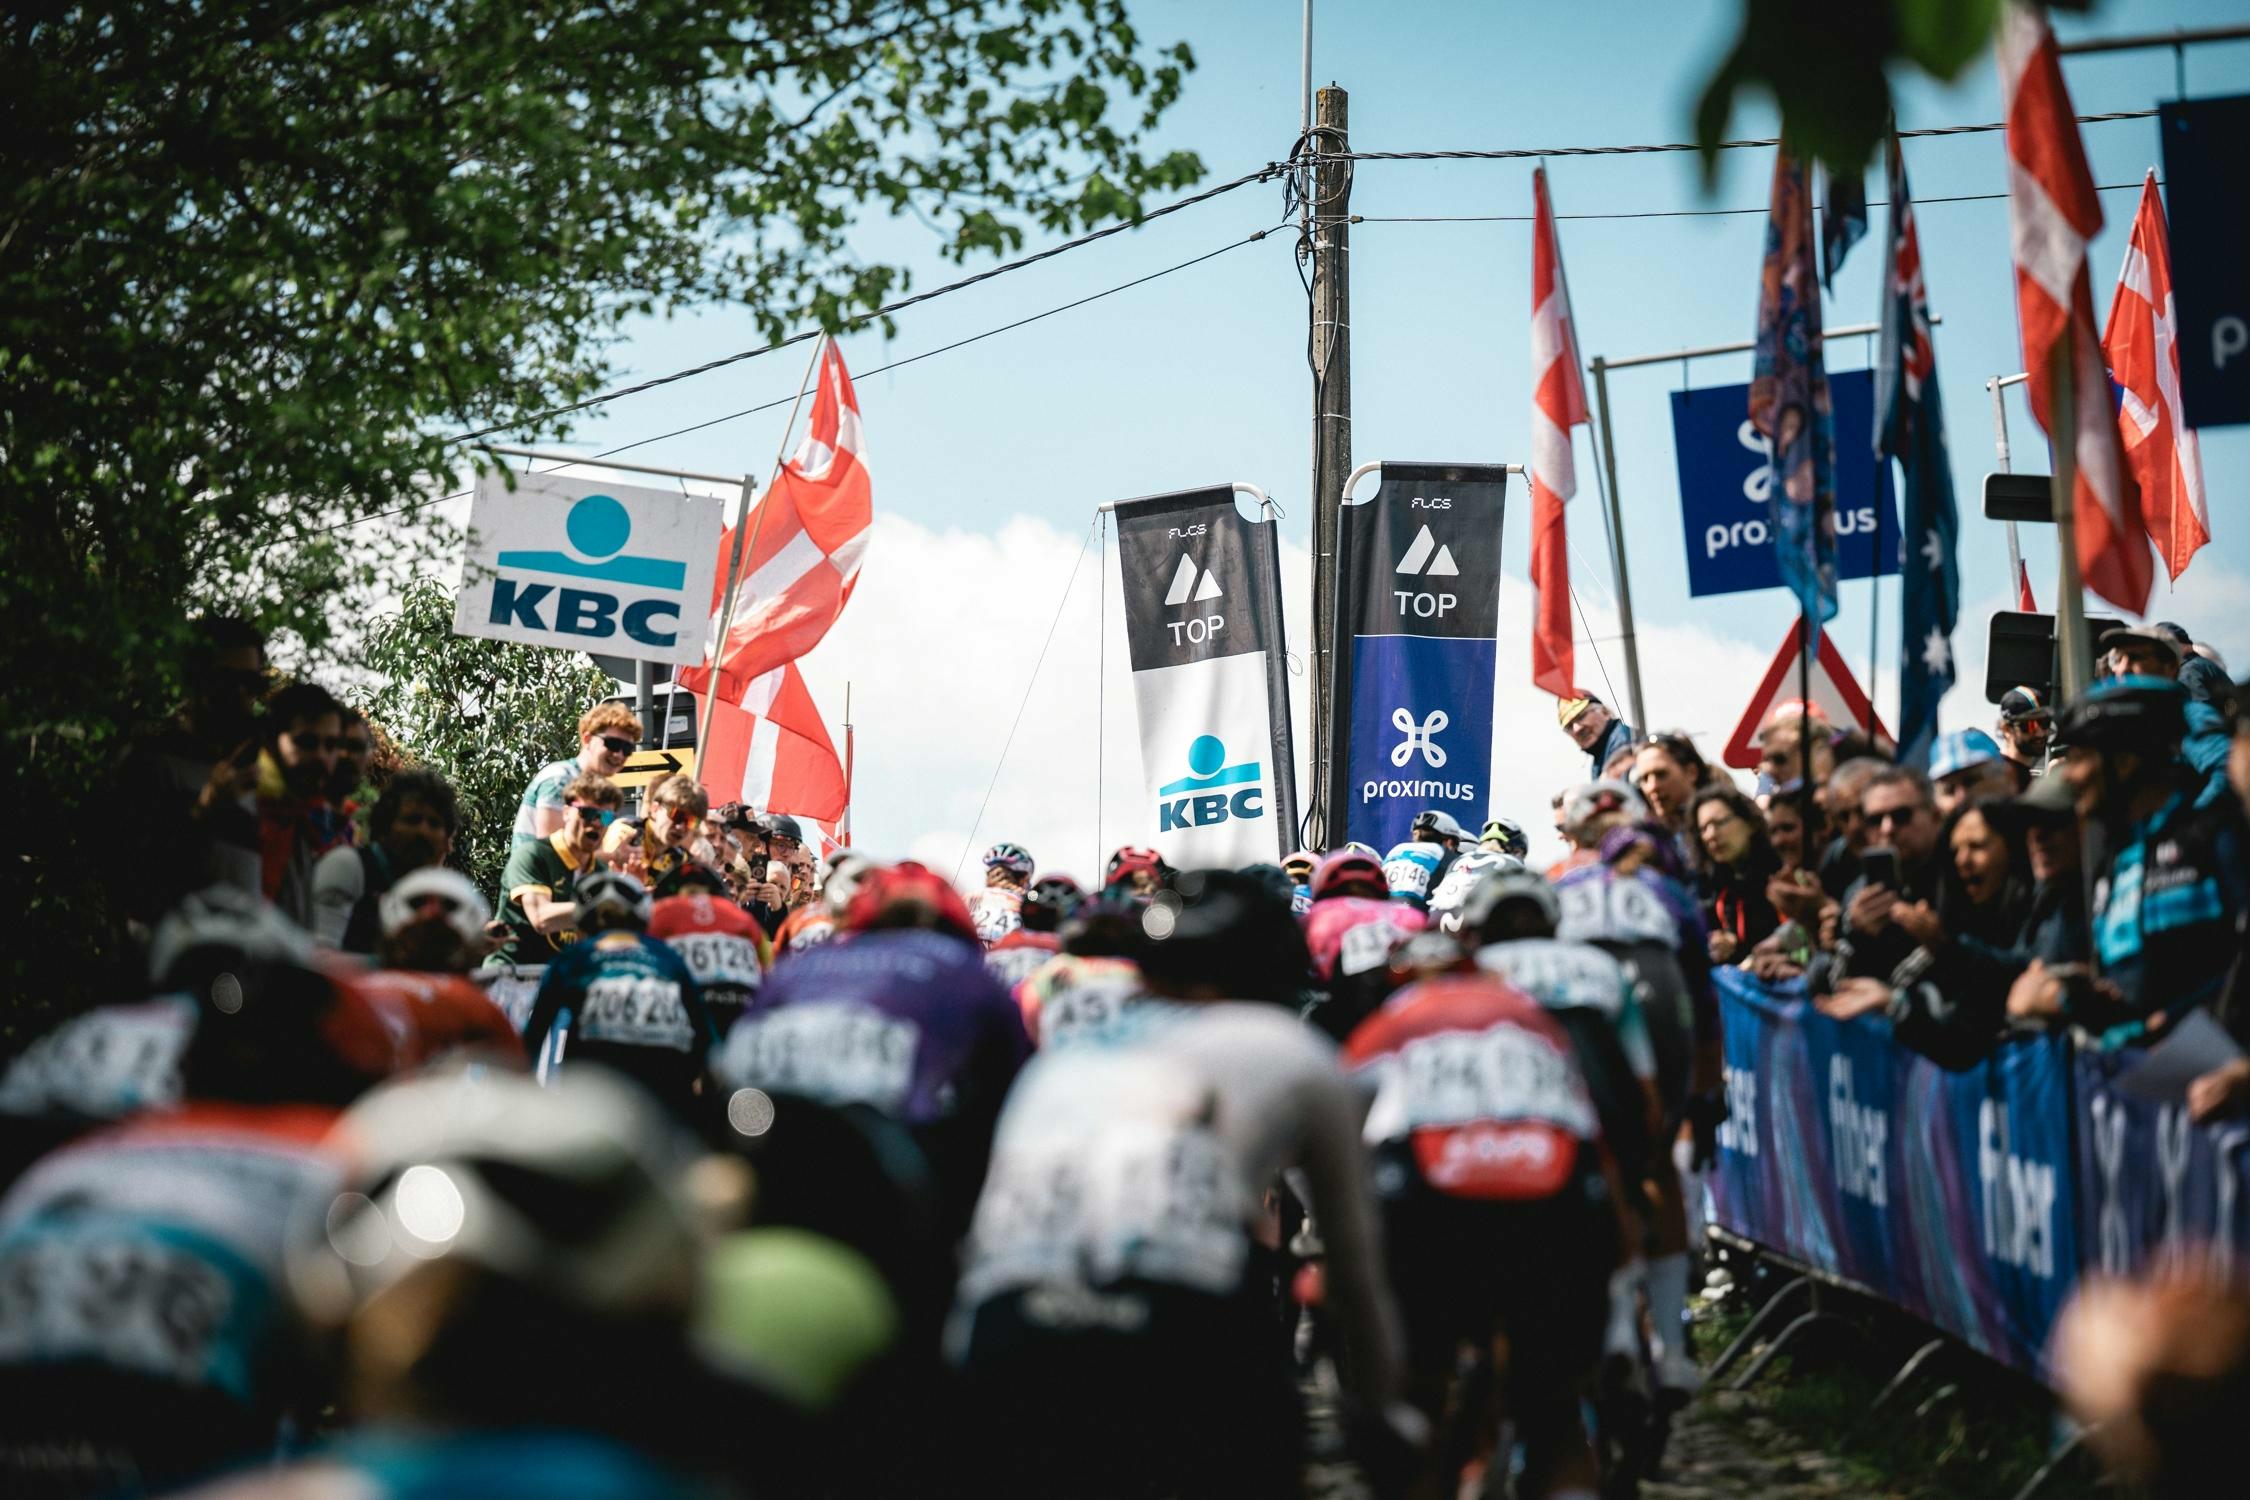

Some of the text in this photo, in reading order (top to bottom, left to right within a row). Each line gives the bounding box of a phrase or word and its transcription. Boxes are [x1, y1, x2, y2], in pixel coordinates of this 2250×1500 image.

[1410, 497, 1452, 510] FLCS
[1168, 523, 1208, 540] FLCS
[1705, 507, 1878, 559] prous
[488, 577, 682, 648] KBC
[1393, 590, 1458, 618] TOP
[1166, 614, 1225, 647] TOP
[1363, 780, 1475, 804] proximus
[1159, 787, 1264, 833] KBC
